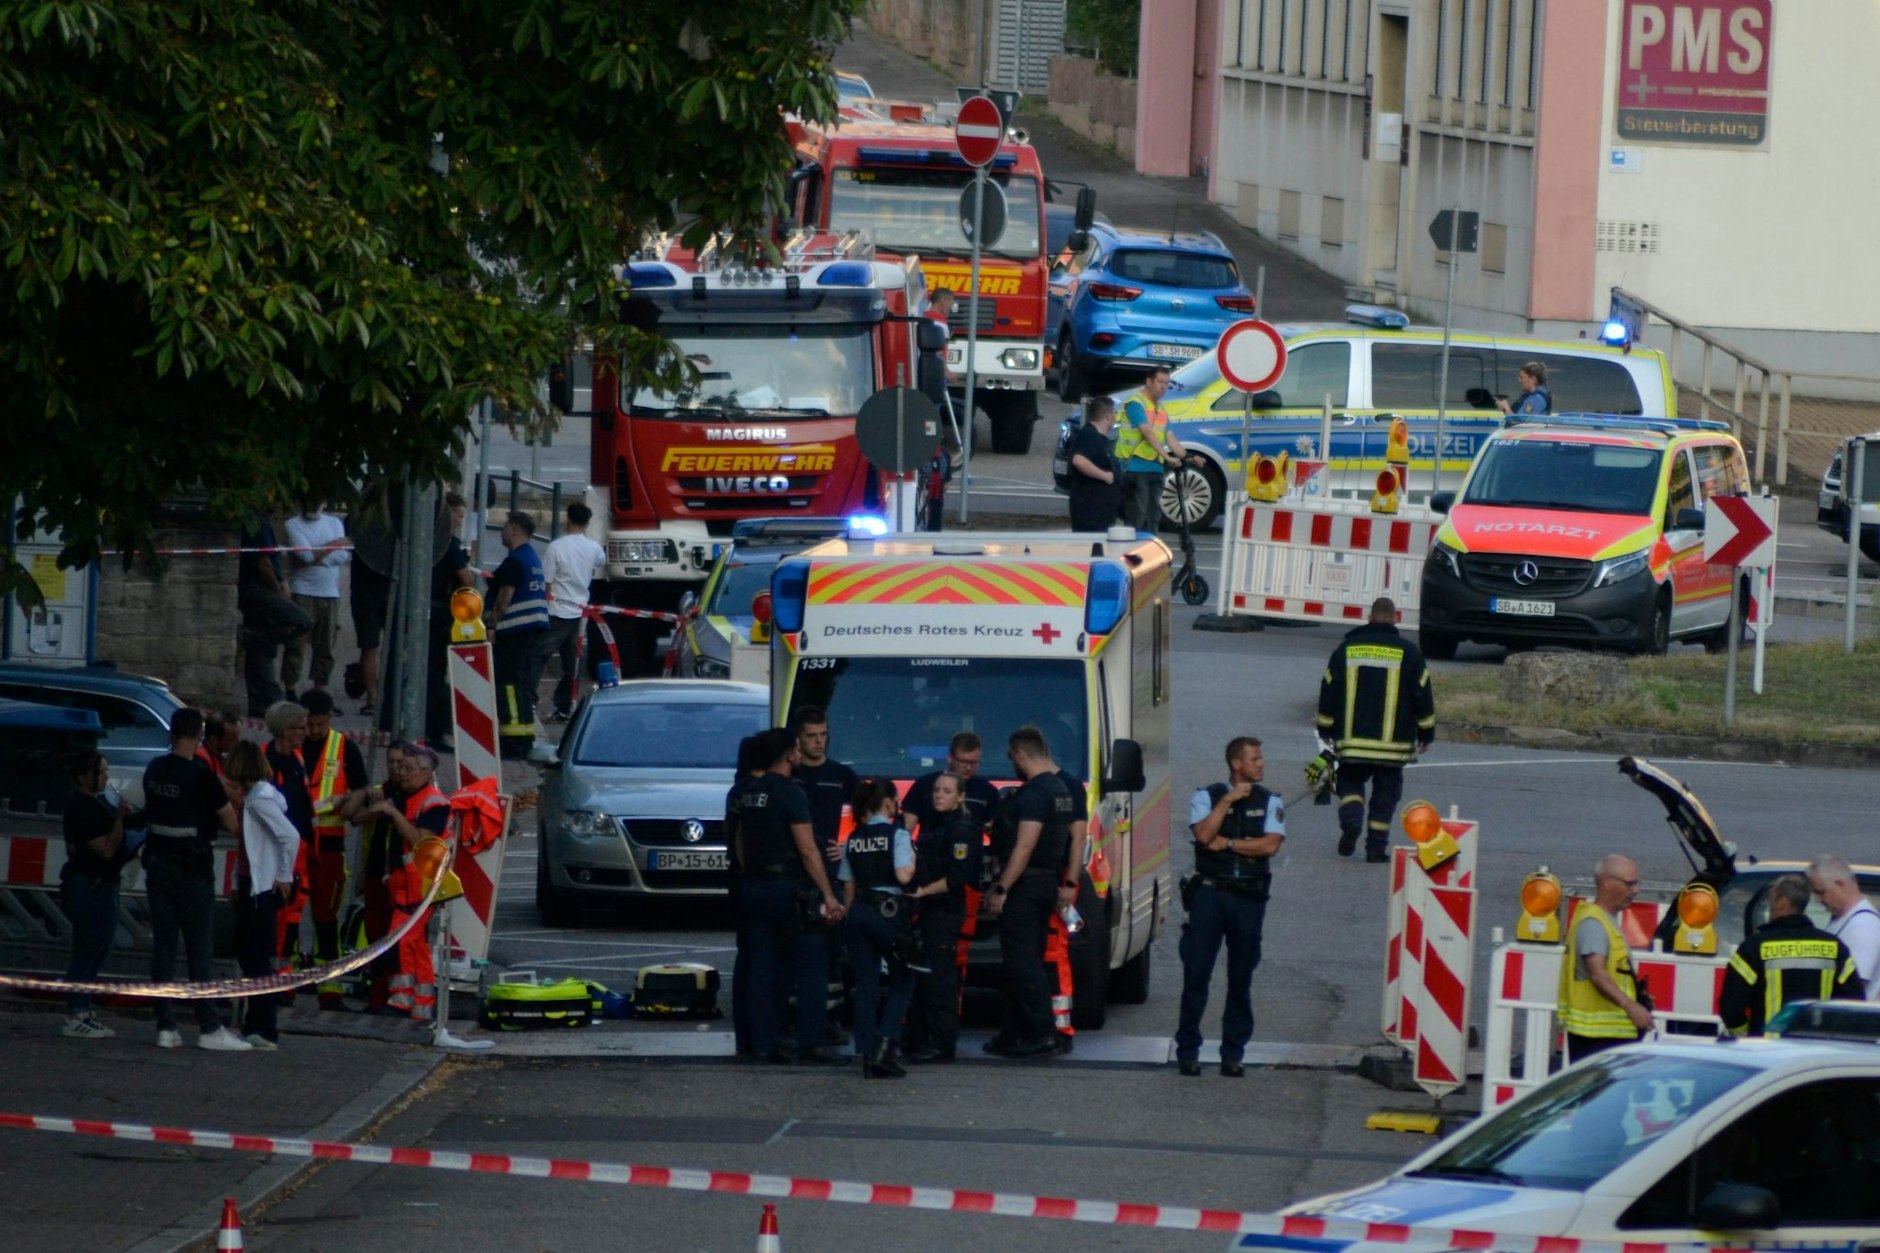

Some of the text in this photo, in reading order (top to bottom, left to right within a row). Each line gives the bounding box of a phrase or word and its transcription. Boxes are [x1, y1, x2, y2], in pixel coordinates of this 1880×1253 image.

[1628, 4, 1763, 75] PMS
[1624, 116, 1759, 139] Steuerberatung
[706, 428, 787, 441] MAGIRUS
[1407, 433, 1475, 454] OLIZEI
[661, 446, 836, 472] FEUERWEHR
[706, 476, 790, 493] IVECO
[1474, 522, 1602, 539] NOTARZT
[1497, 601, 1510, 612] SB
[1527, 603, 1553, 615] 1621
[823, 624, 1024, 637] Deutsches Rotes Kreuz
[801, 658, 969, 670] 1331 LUDWEILER
[849, 837, 889, 854] POLIZEI
[657, 854, 676, 868] BP
